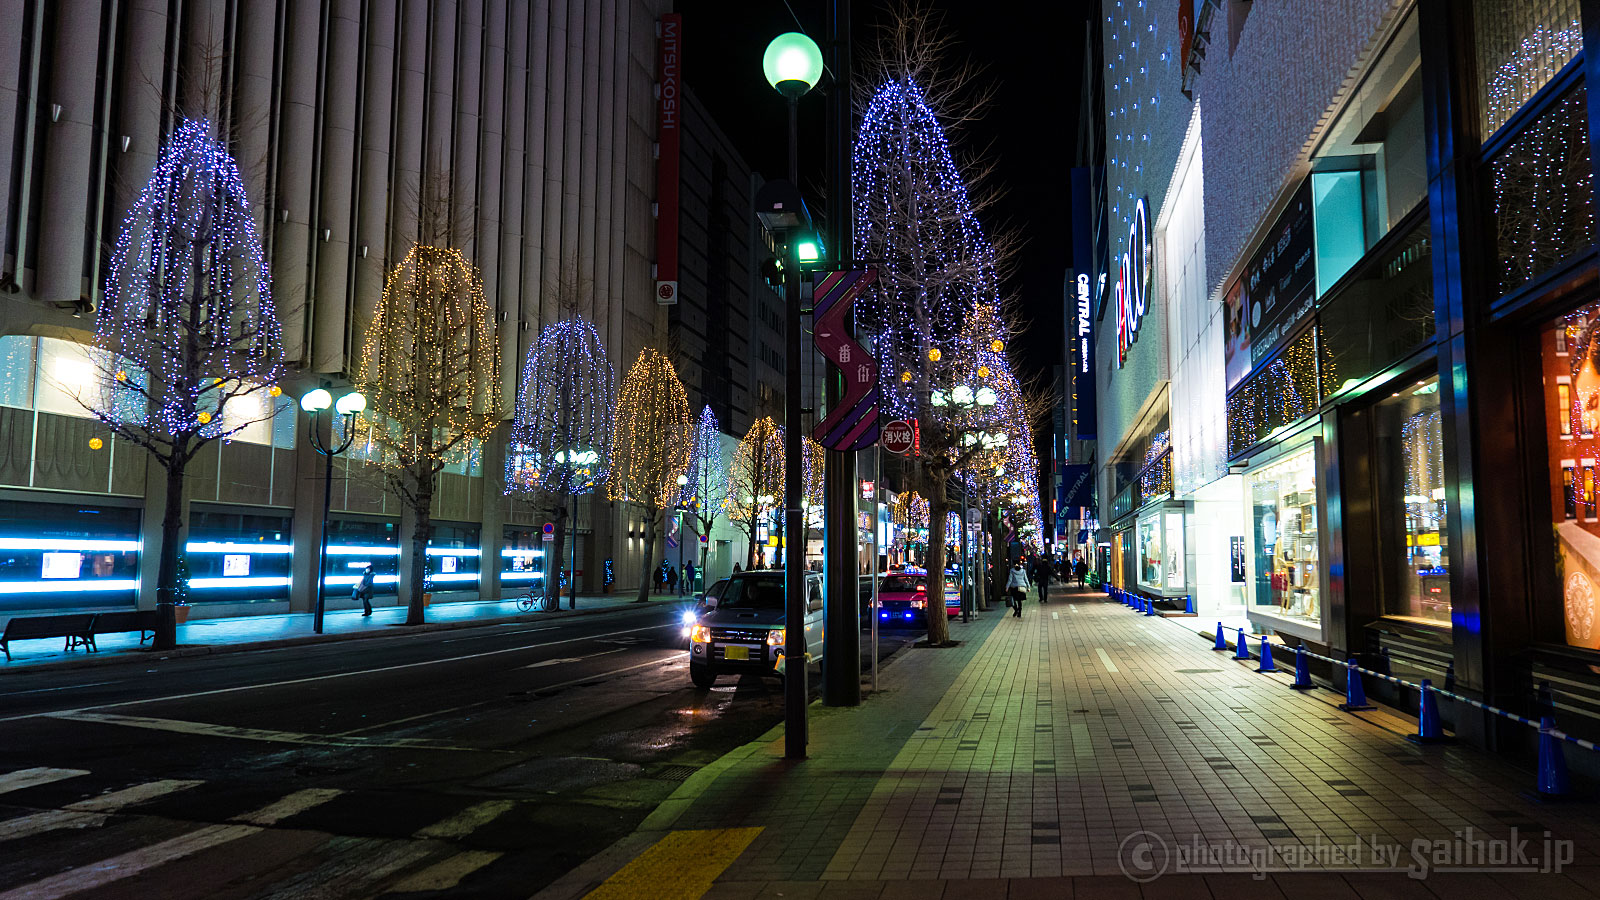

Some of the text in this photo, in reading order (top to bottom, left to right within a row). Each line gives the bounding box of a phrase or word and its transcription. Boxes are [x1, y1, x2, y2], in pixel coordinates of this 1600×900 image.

[662, 22, 677, 129] MITSUKOSHI
[1077, 273, 1091, 337] CENTRAL
[1115, 197, 1147, 370] PARCO
[819, 333, 871, 383] 一番街
[884, 430, 911, 444] 消火栓
[1064, 471, 1089, 504] CENTRAL
